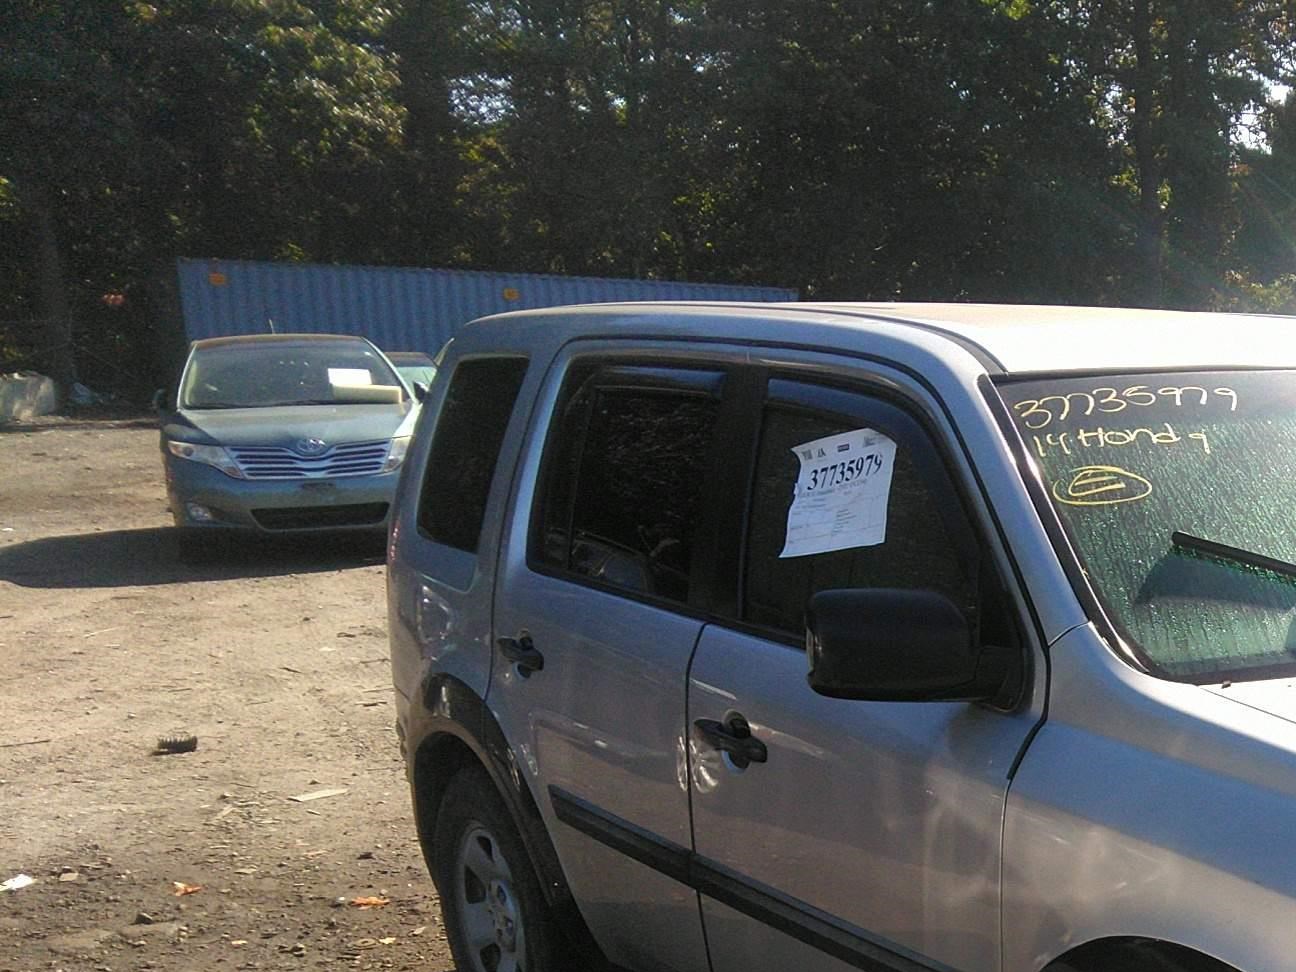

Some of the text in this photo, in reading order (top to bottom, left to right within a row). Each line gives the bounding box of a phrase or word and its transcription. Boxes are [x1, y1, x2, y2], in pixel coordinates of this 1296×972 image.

[1013, 385, 1238, 429] 37735979
[1033, 430, 1071, 457] 14
[807, 453, 883, 491] 37735979
